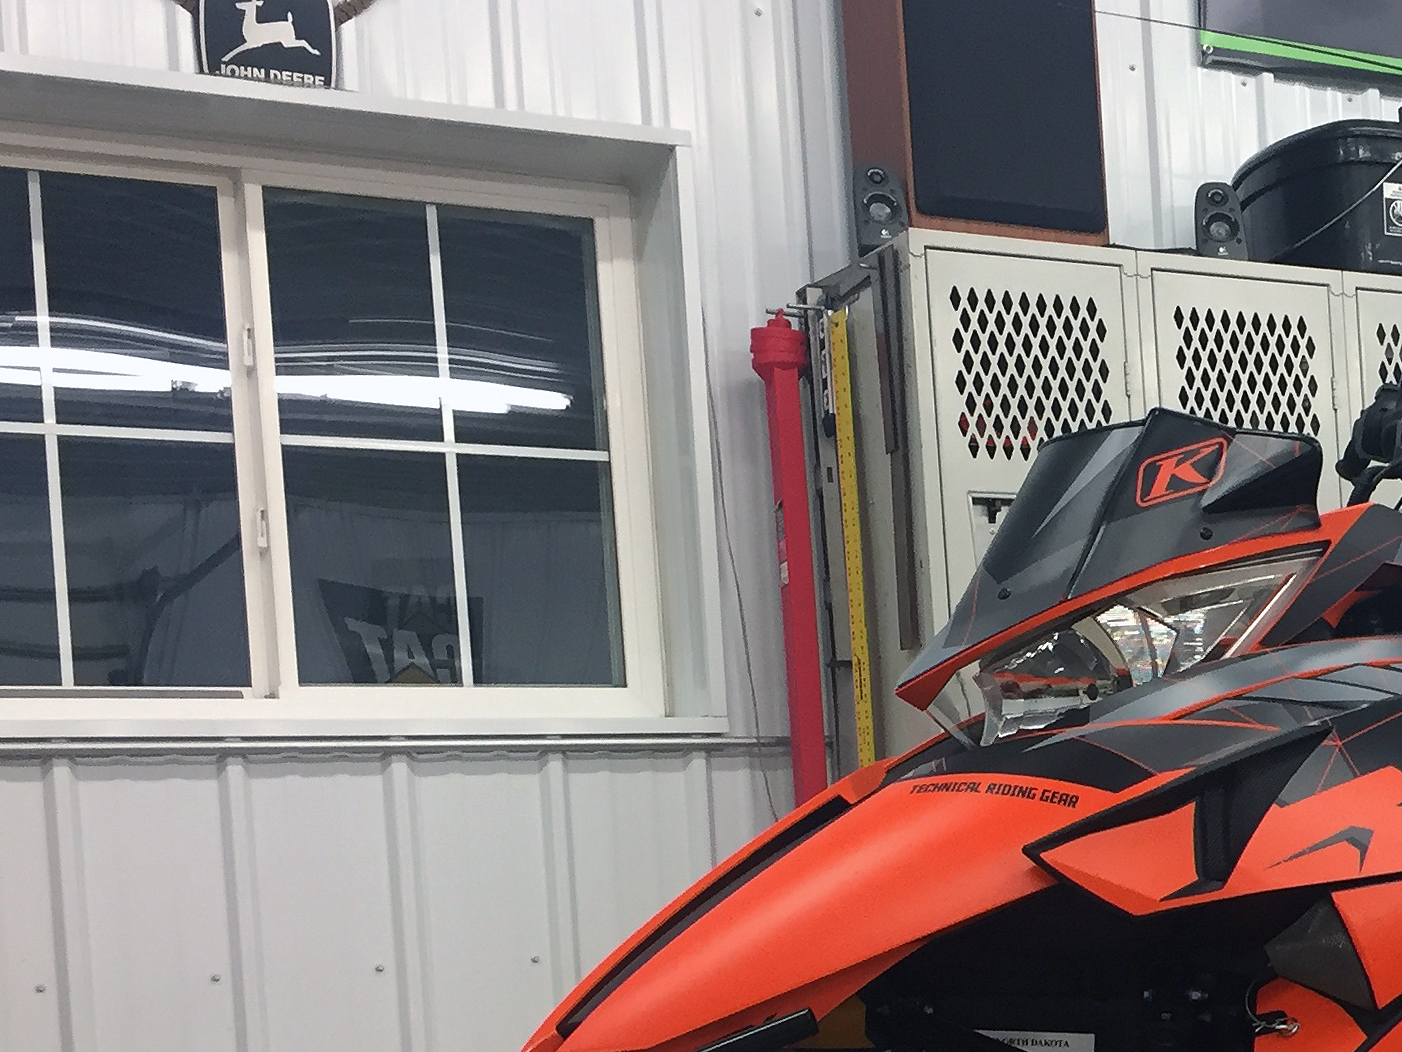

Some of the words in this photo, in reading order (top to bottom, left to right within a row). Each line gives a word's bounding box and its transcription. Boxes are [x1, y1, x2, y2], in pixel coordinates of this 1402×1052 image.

[215, 64, 265, 79] JOHN
[269, 69, 325, 86] DEERE
[910, 782, 981, 794] TECHNICAL
[985, 782, 1038, 800] RIDING
[1039, 789, 1080, 808] GEAR
[1031, 1039, 1070, 1048] DAKOTA
